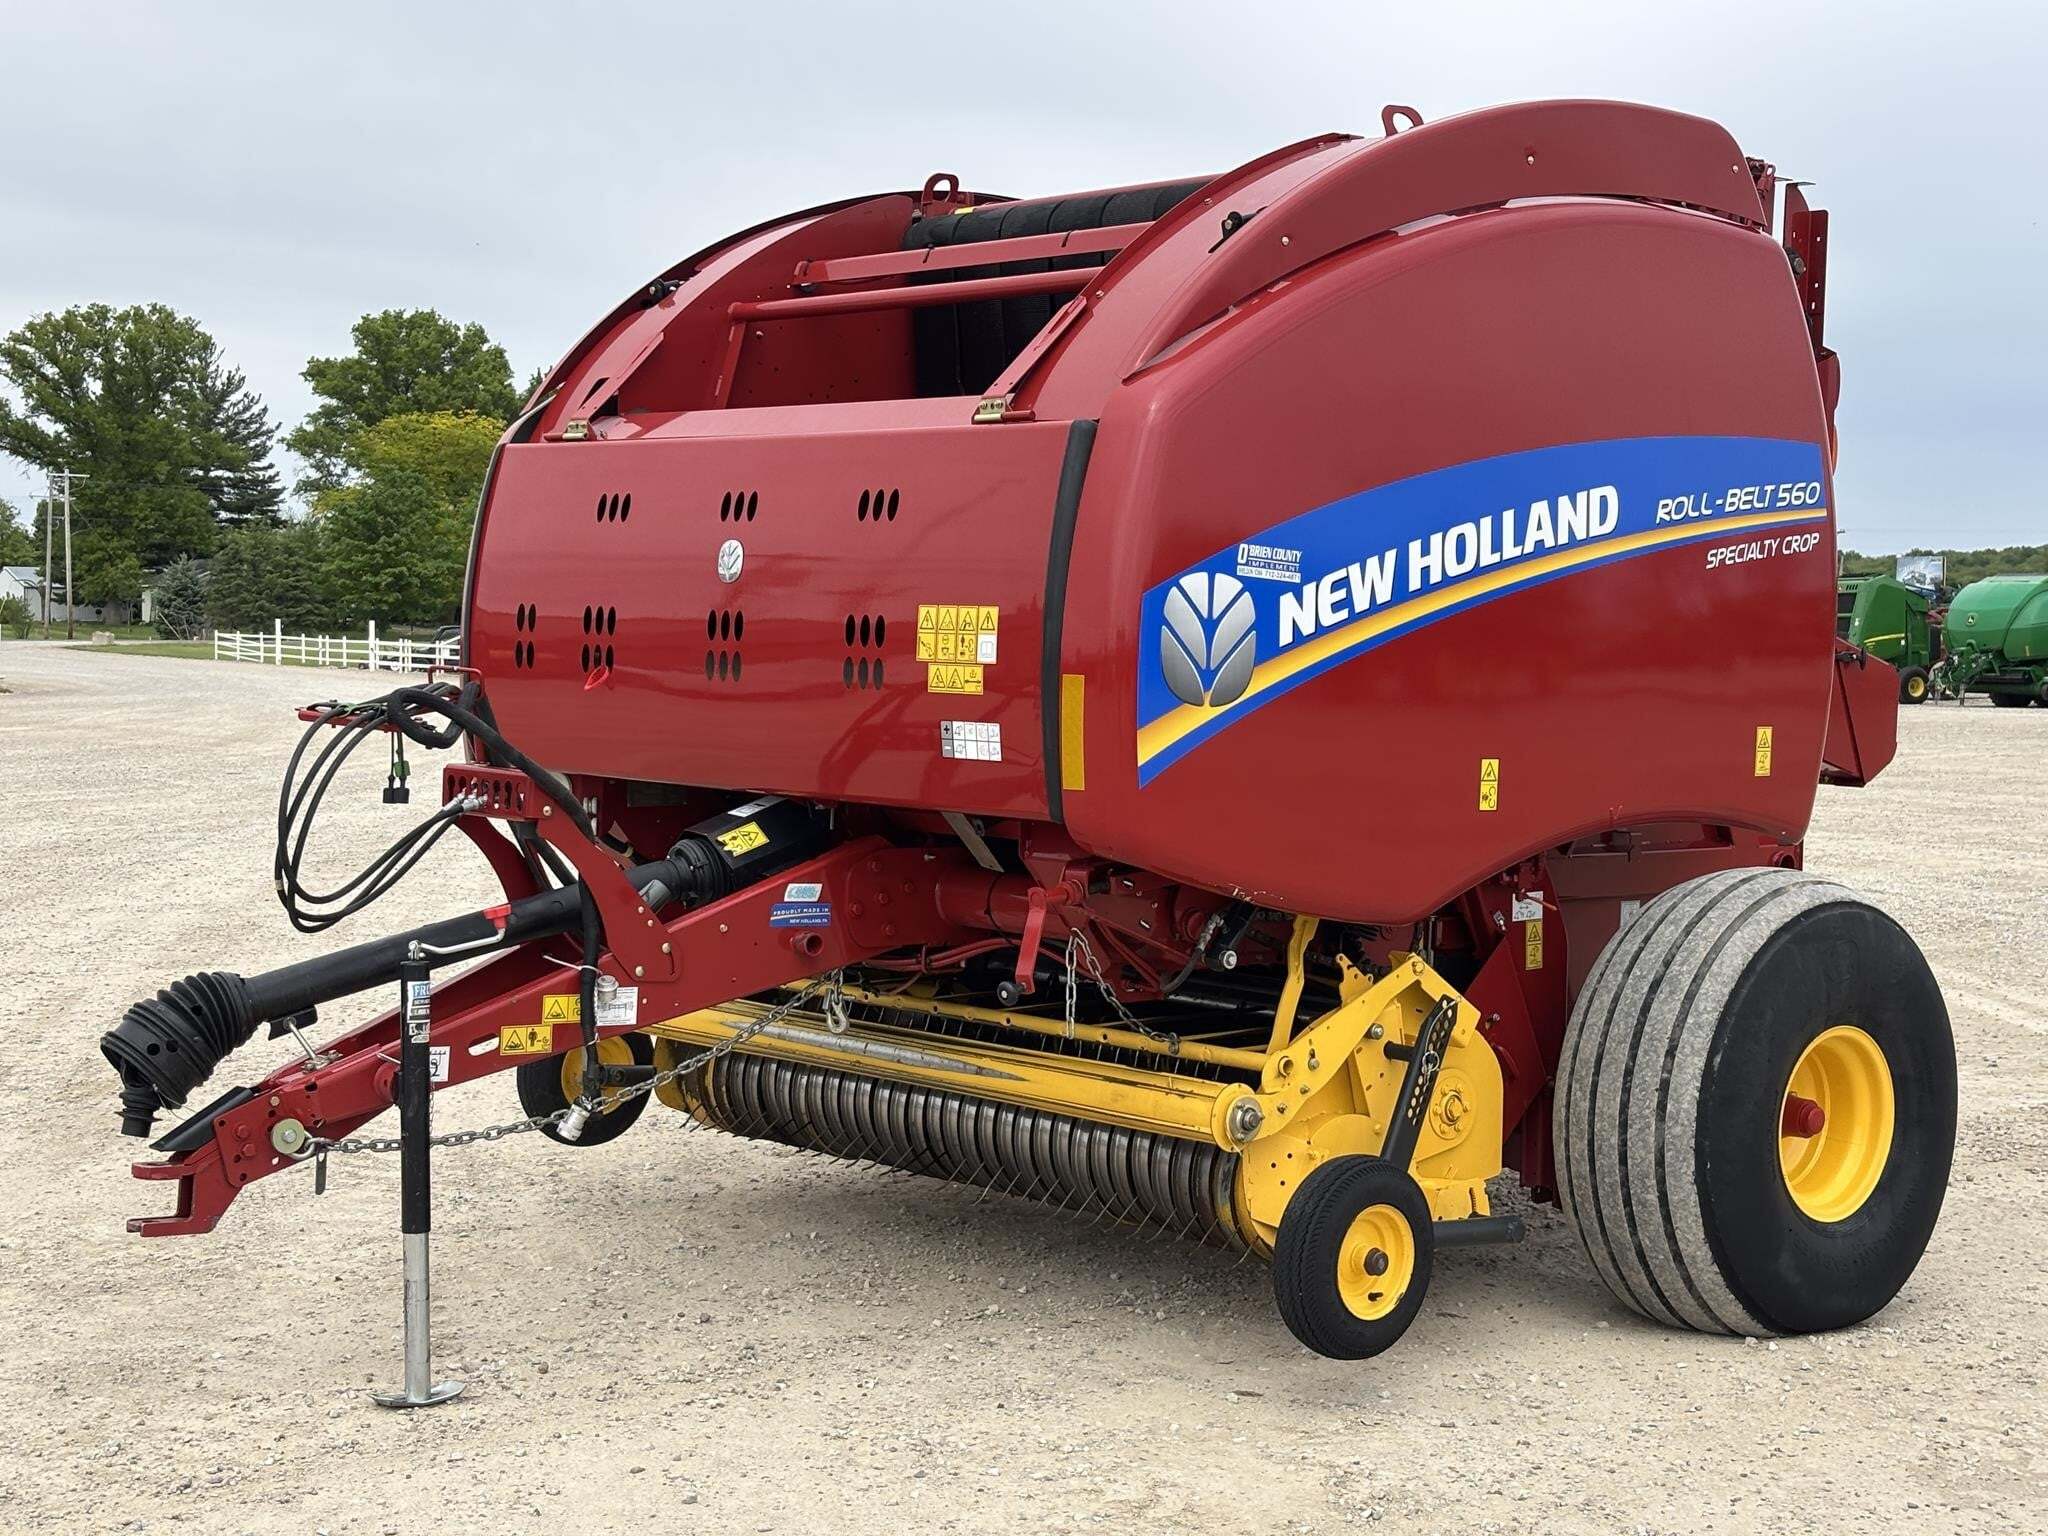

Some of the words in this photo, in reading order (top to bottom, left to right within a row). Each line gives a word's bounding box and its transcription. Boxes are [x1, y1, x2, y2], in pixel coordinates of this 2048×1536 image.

[1776, 481, 1821, 508] 560
[1272, 547, 1303, 563] COUNTY
[1705, 537, 1780, 570] SPECIALTY
[1782, 532, 1820, 555] CROP
[1248, 560, 1300, 572] IMPLEMENT
[1279, 548, 1398, 648] NEW
[1408, 485, 1619, 593] HOLLAND
